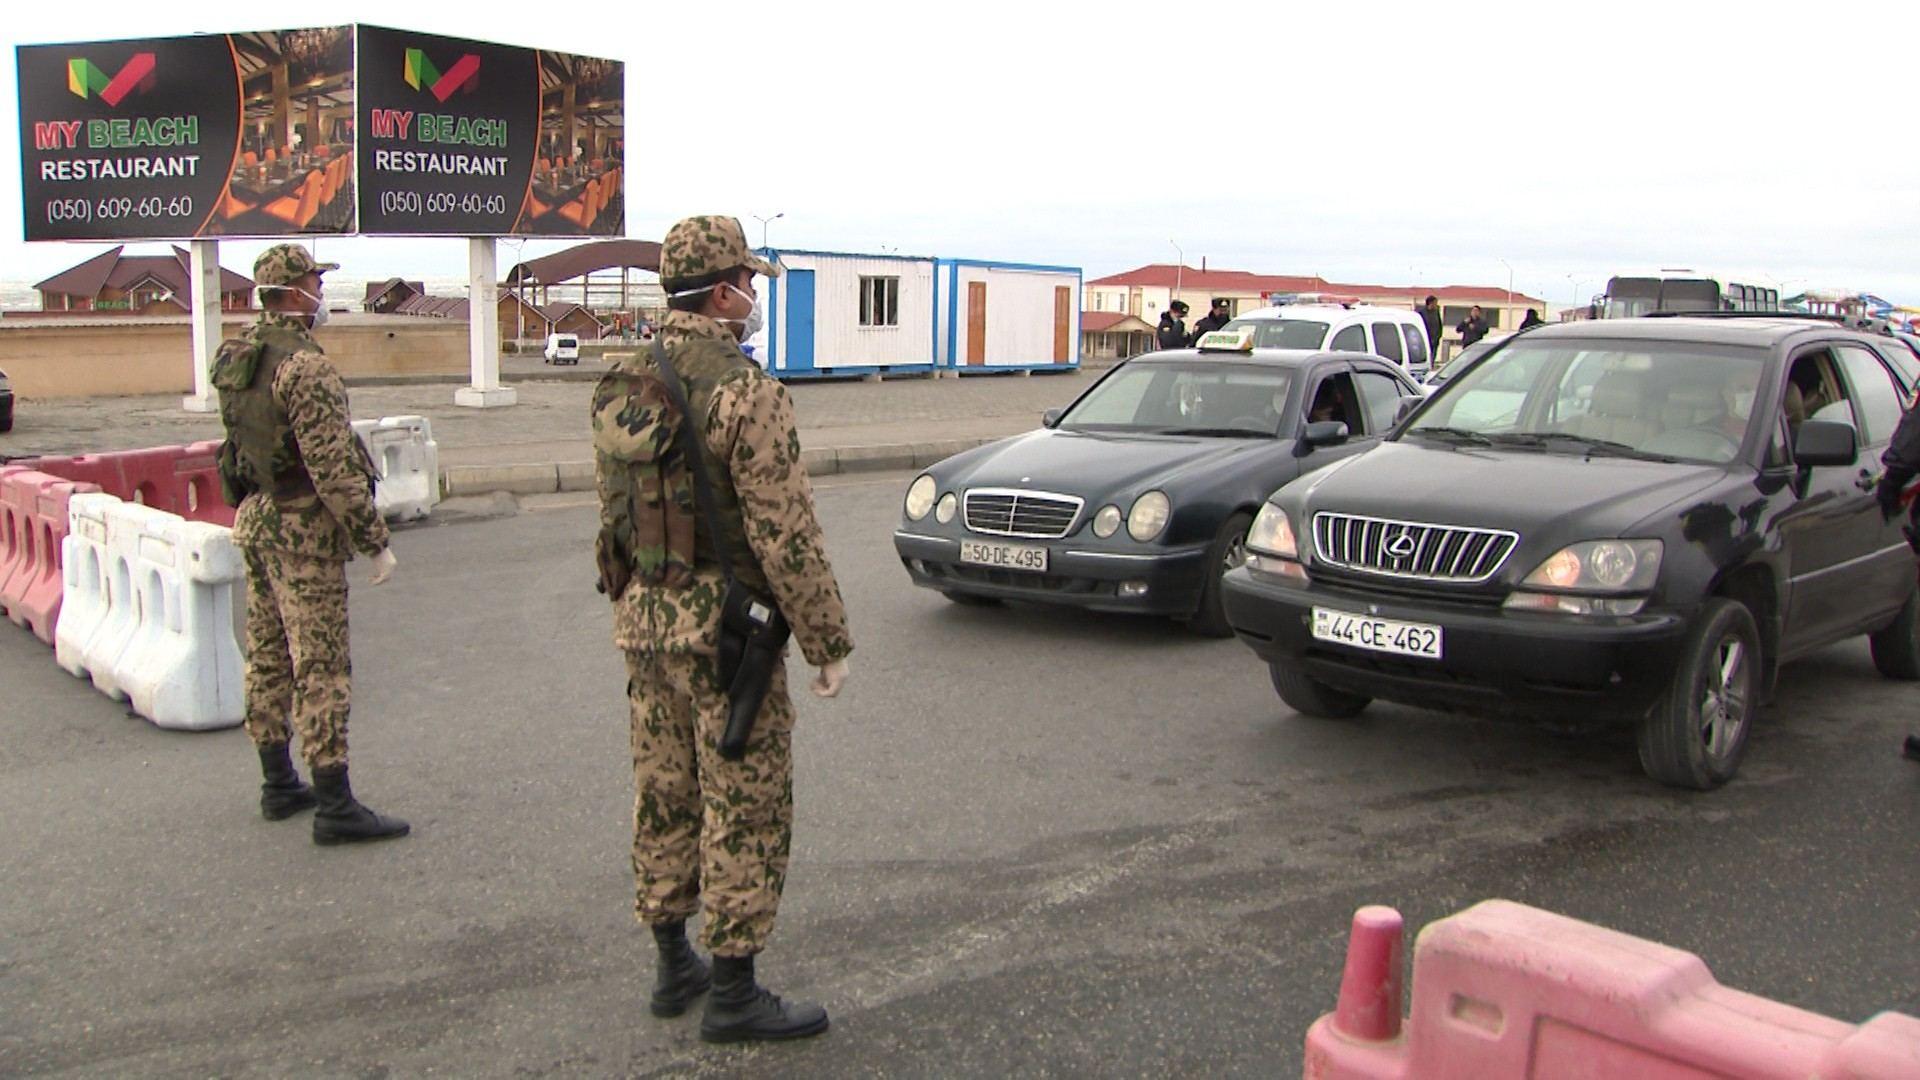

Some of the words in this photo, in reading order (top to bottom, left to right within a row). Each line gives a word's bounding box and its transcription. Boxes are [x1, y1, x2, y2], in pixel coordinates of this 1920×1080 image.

[35, 121, 82, 150] MY
[87, 115, 199, 149] BEACH
[371, 109, 414, 140] MY
[417, 113, 507, 148] BEACH
[41, 155, 200, 180] RESTAURANT
[375, 150, 508, 176] RESTAURANT
[47, 198, 92, 224] (050)
[97, 194, 193, 218] 609-60-60
[381, 191, 422, 216] (050)
[426, 192, 505, 214] 609-60-60
[1331, 616, 1436, 654] 44-CE-462
